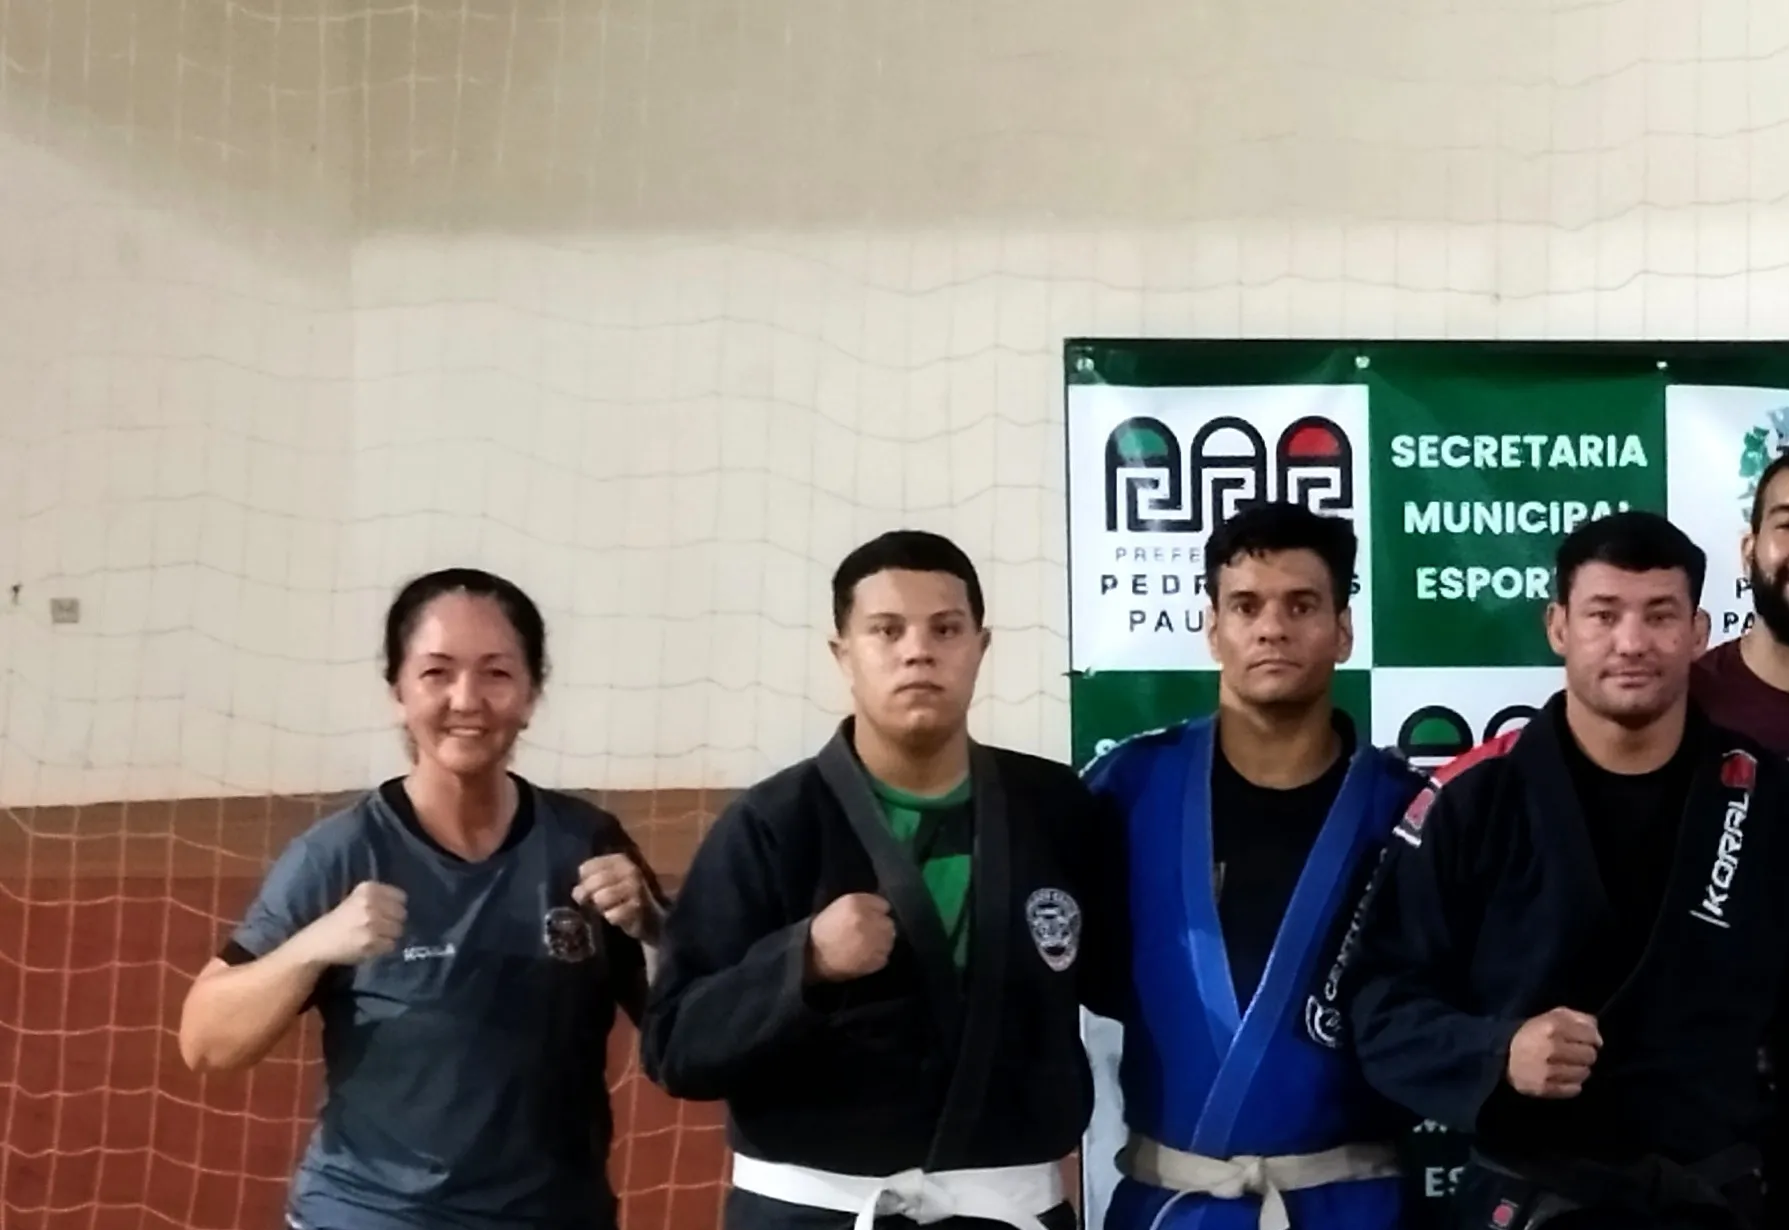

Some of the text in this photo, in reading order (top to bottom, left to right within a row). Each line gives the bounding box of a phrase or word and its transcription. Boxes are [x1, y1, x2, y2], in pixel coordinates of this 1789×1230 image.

[1391, 434, 1648, 468] SECRETARIA
[1403, 501, 1632, 534] MUNICIP
[1416, 566, 1549, 600] ESPOR
